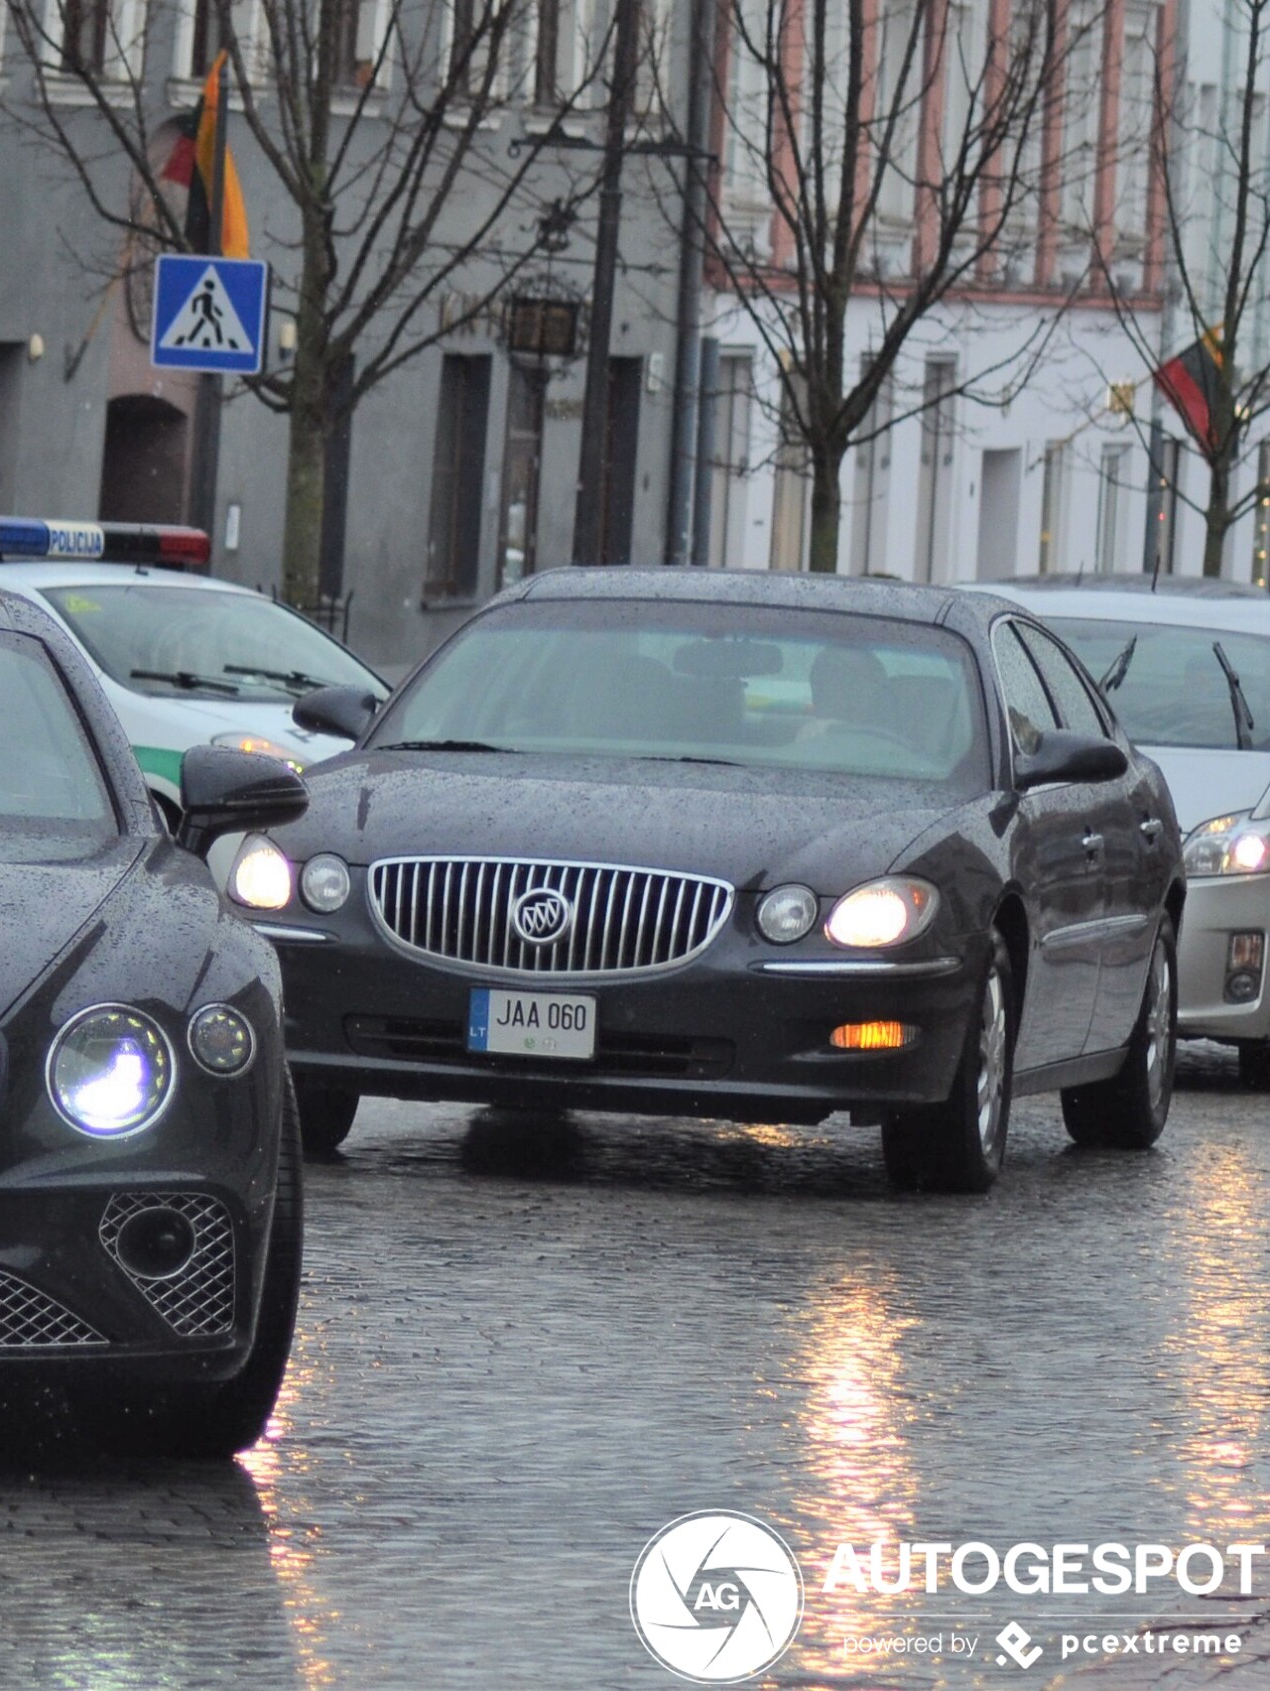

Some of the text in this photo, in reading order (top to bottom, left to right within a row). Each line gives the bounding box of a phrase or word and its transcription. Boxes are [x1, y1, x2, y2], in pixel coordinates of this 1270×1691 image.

[50, 530, 101, 555] POLICIJA
[496, 999, 587, 1031] JAA 060
[470, 1026, 486, 1038] LT
